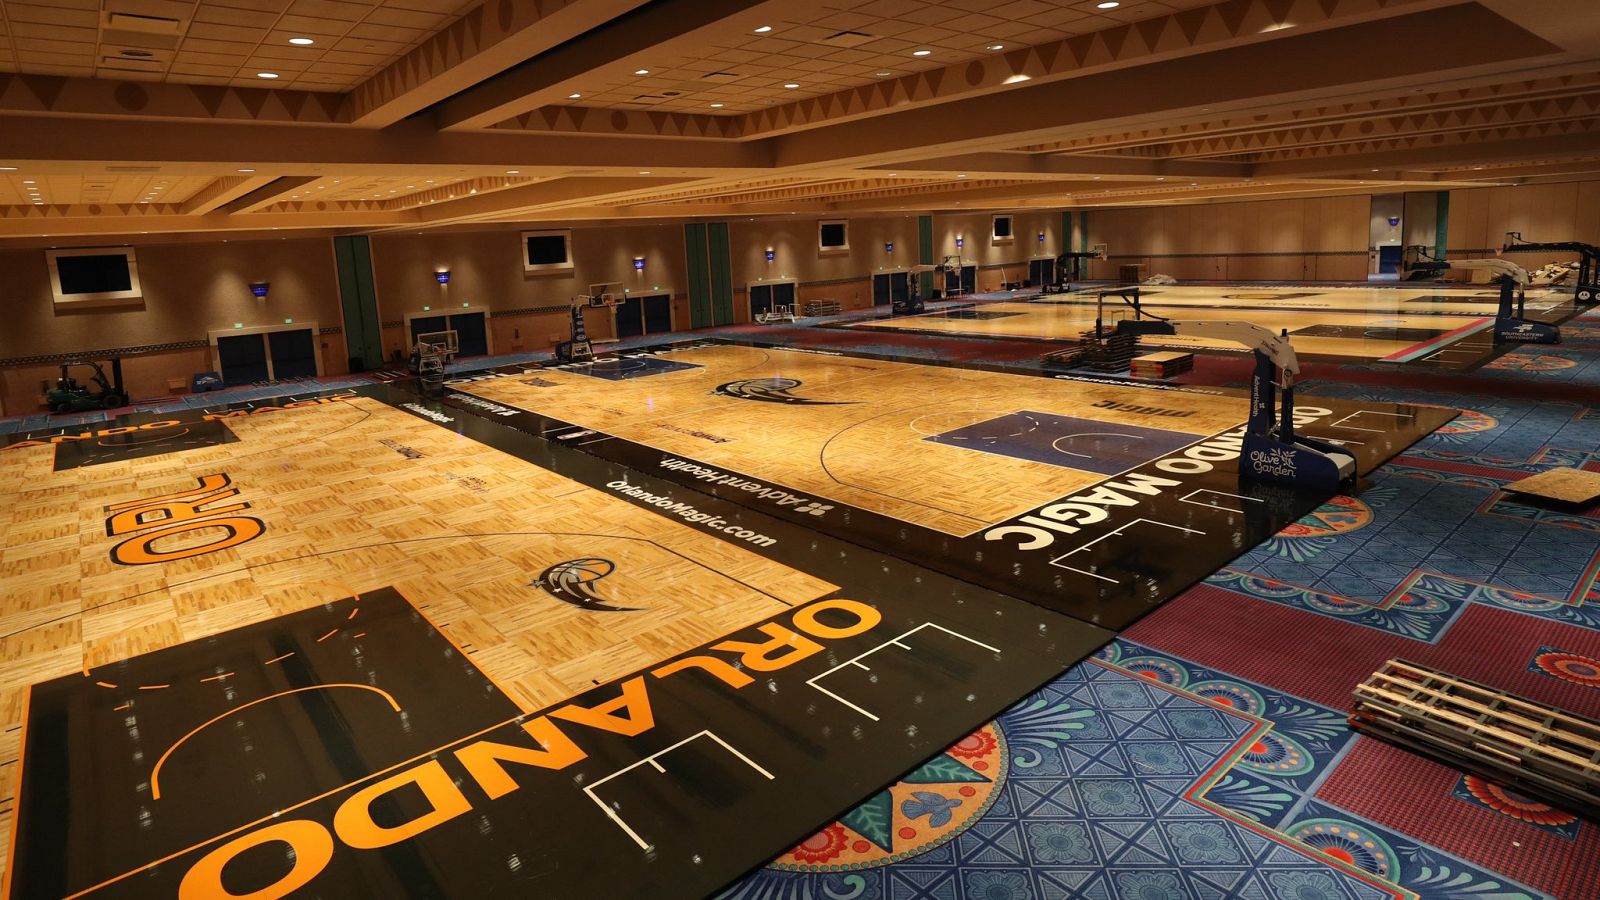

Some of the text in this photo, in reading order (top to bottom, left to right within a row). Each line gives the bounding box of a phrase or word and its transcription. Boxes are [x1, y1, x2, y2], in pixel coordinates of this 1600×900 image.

[1055, 374, 1224, 396] OrlandoMagic.com
[1252, 375, 1261, 417] AdventHealth
[984, 406, 1333, 551] ONDO MAGIC
[1250, 450, 1280, 465] Olive
[1253, 461, 1297, 478] Garden
[660, 458, 808, 507] AdventHealth
[103, 472, 267, 566] ORL
[606, 480, 777, 547] OrlandoMagic.com
[178, 599, 882, 900] ORLANDO
